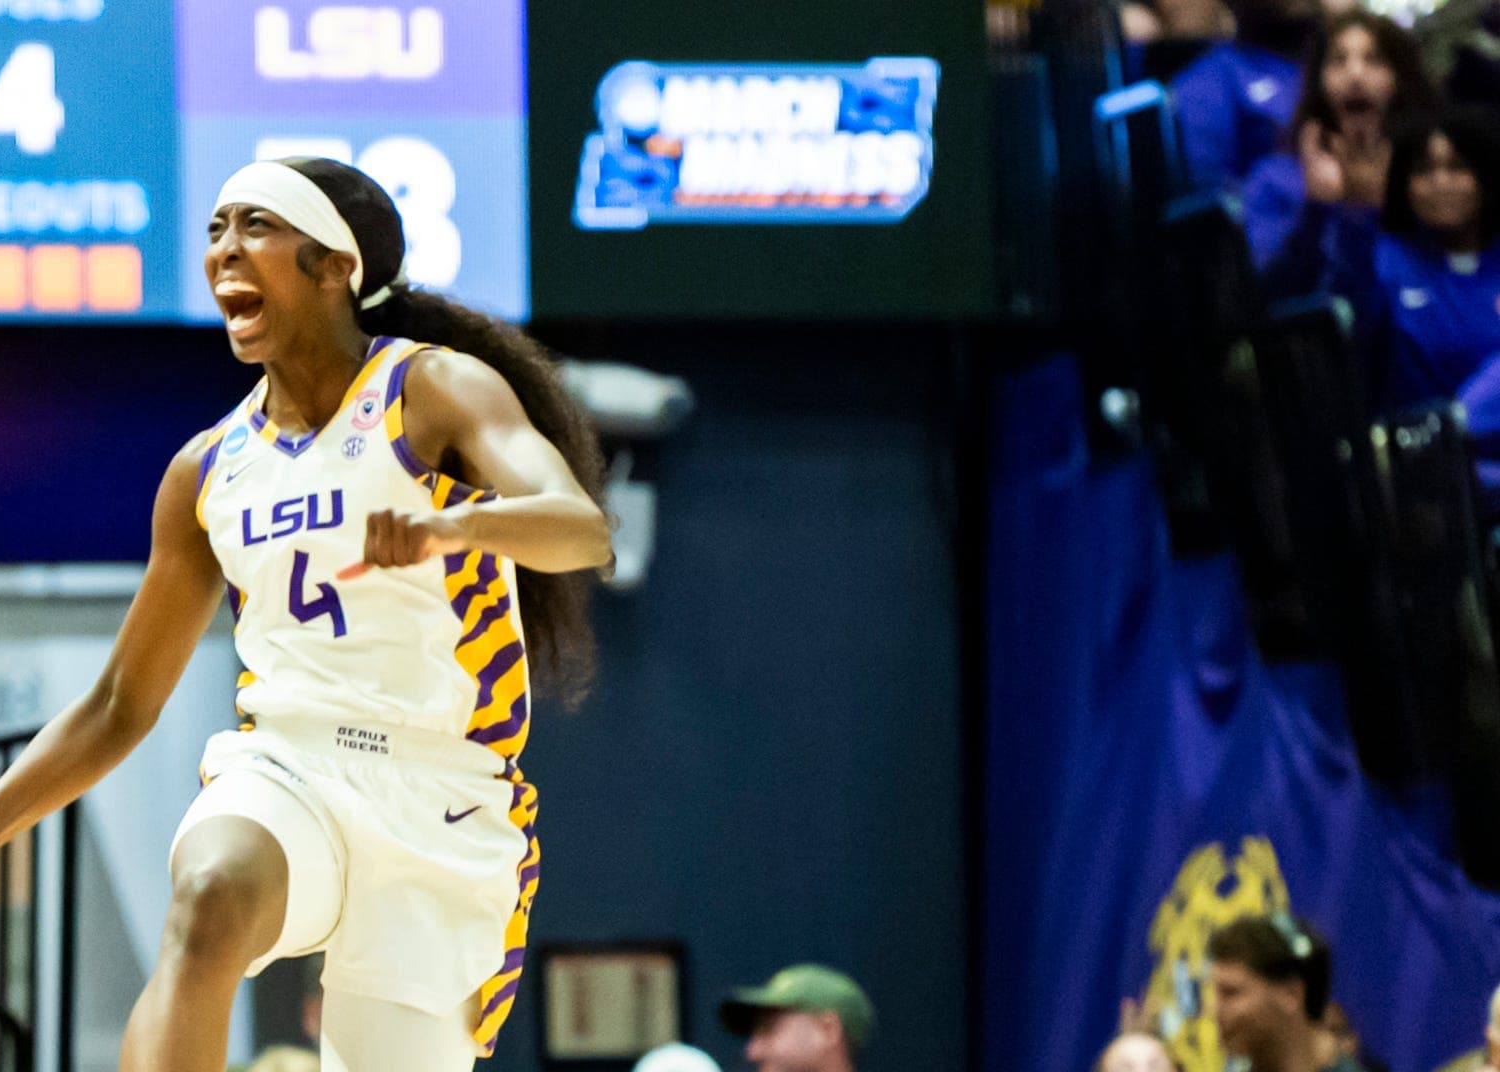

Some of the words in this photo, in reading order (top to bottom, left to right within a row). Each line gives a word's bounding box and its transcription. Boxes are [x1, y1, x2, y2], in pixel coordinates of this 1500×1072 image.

[255, 6, 443, 79] LSU
[242, 489, 344, 547] LSU
[289, 549, 347, 638] 4
[334, 737, 389, 755] TIGERS
[337, 726, 388, 743] BEAUX
